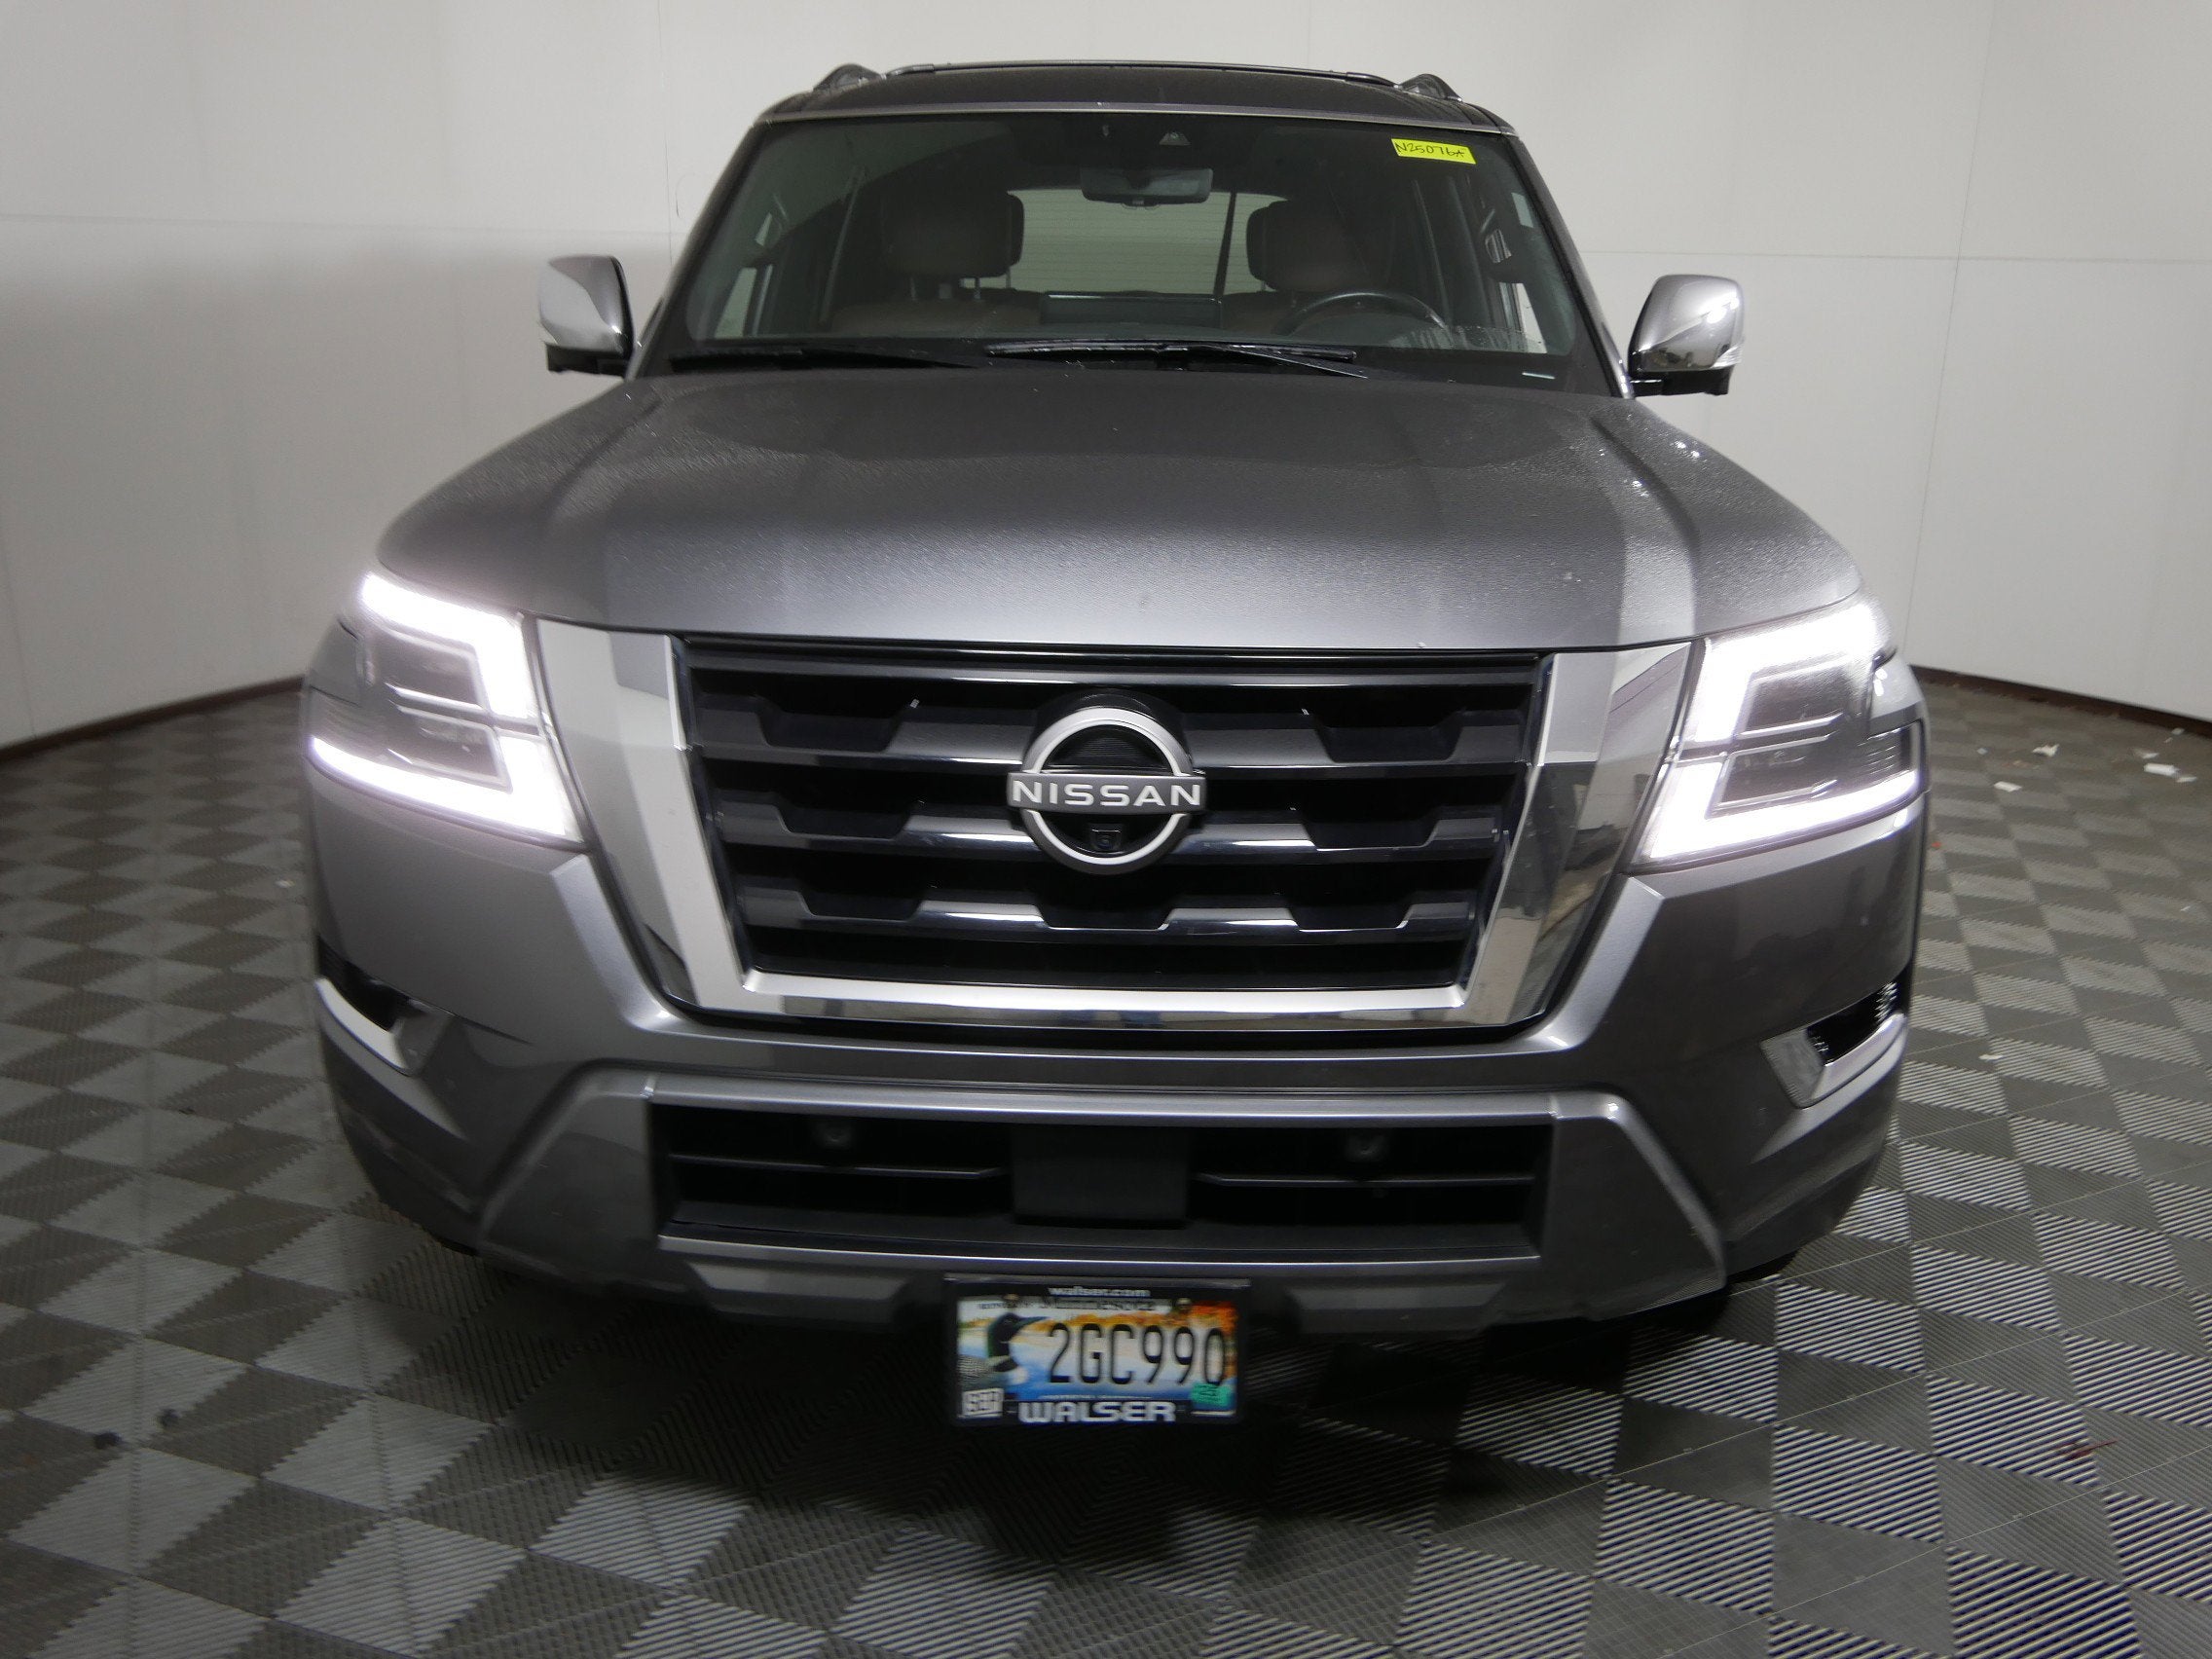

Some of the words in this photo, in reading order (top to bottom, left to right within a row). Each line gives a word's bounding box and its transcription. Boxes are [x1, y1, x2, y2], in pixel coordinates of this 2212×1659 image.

[1014, 781, 1200, 806] NISSAN
[1049, 1286, 1152, 1298] walser.com
[1049, 1322, 1226, 1384] 2GC990
[1018, 1402, 1176, 1422] WALSER
